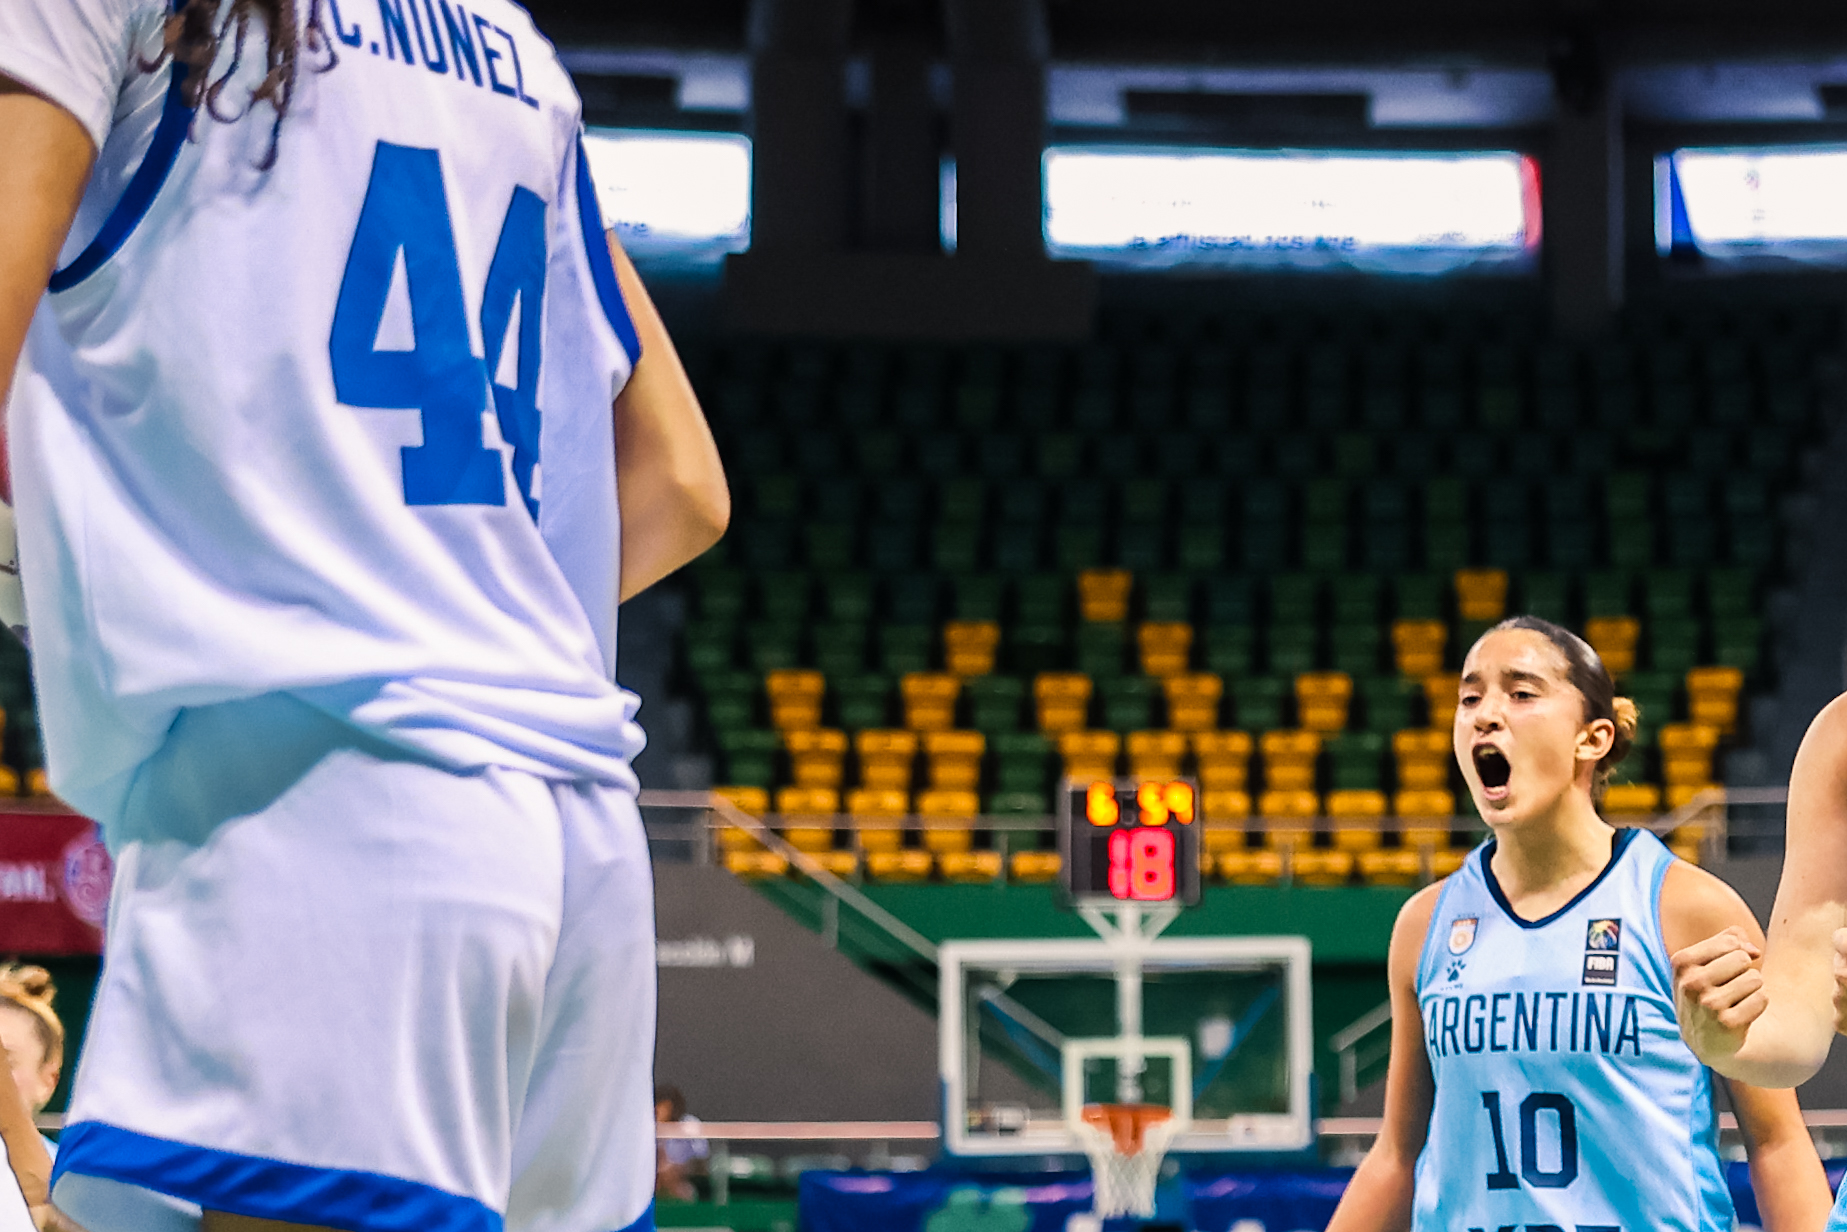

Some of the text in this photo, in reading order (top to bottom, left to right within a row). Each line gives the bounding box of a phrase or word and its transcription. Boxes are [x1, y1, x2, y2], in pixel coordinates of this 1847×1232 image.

[330, 139, 548, 527] 44
[1108, 827, 1176, 900] 18
[1429, 991, 1642, 1057] ARGENTINA
[1481, 1091, 1579, 1190] 10
